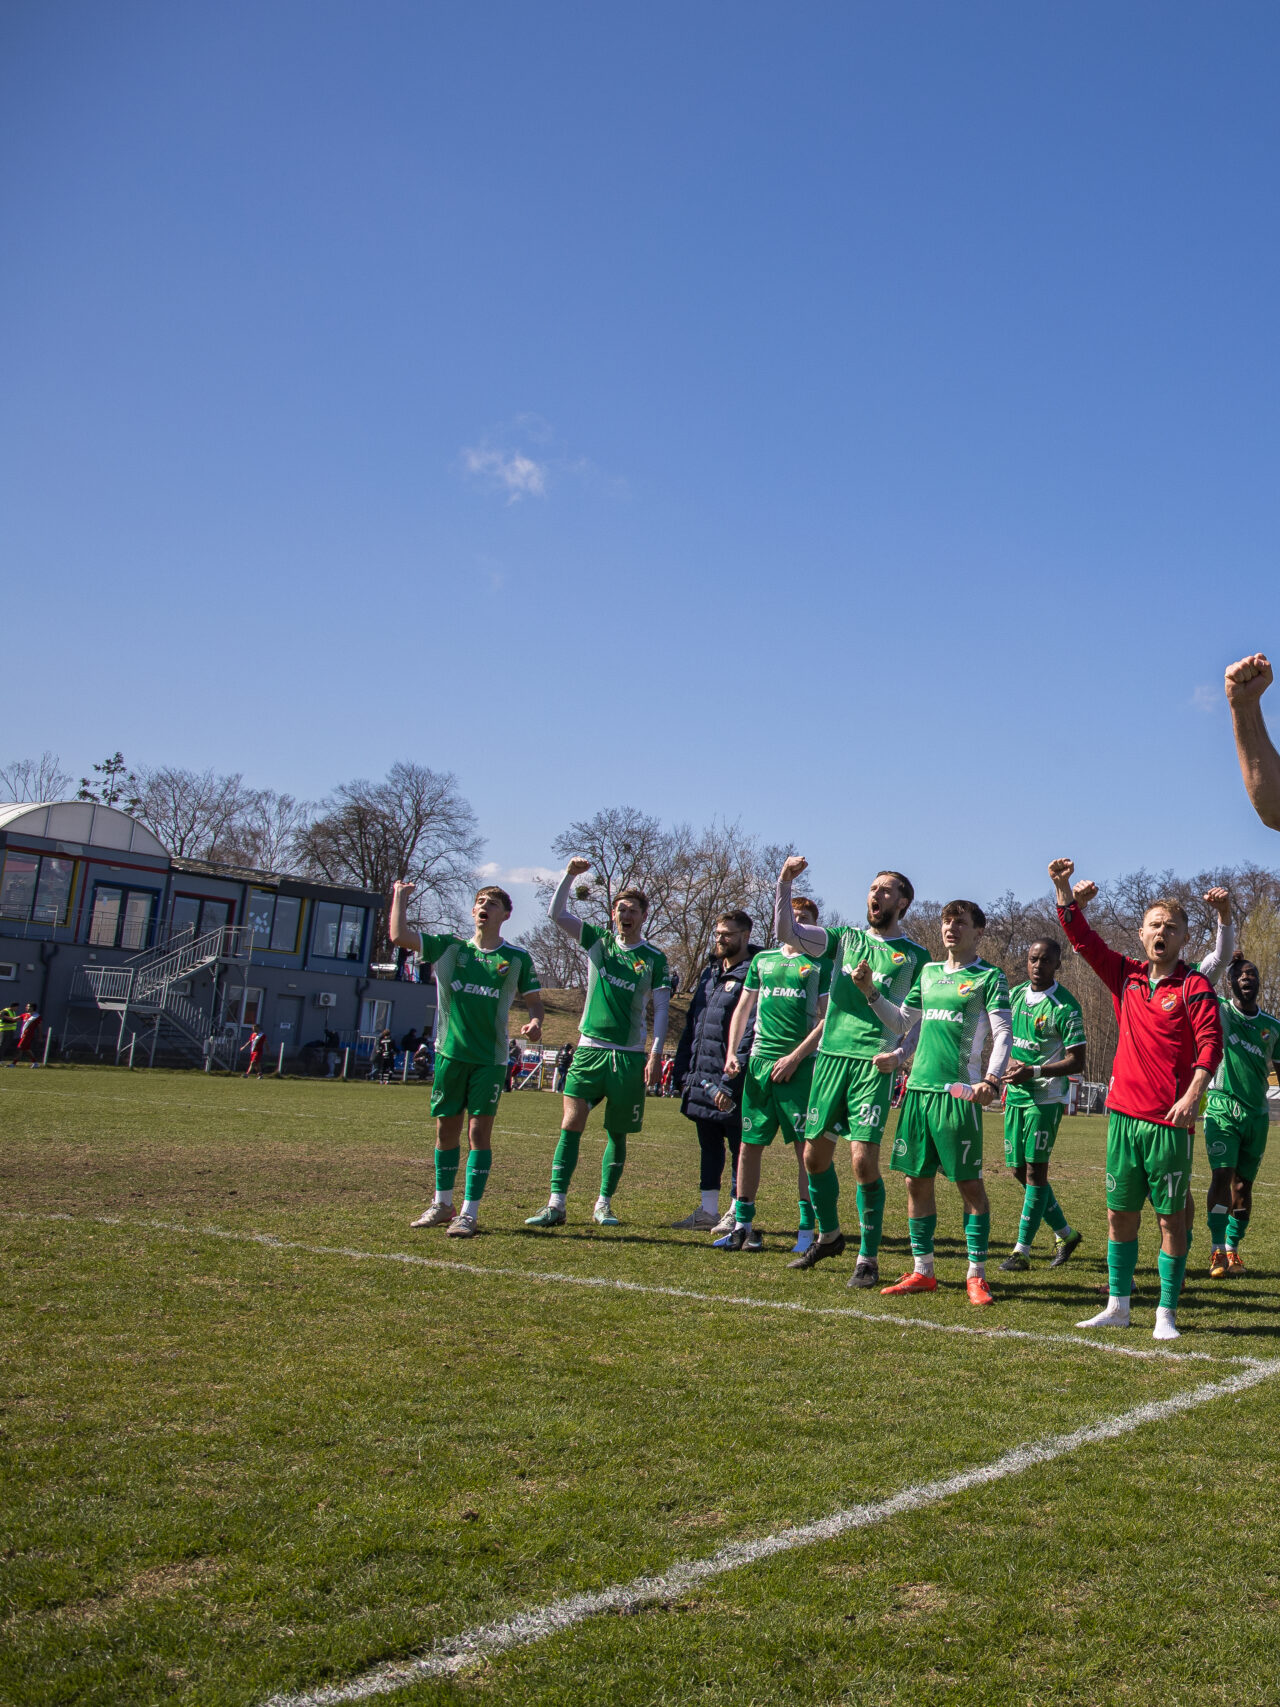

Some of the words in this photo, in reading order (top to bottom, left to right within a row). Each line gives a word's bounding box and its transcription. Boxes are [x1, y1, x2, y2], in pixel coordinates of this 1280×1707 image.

[463, 982, 500, 999] EMKA
[772, 986, 807, 999] EMKA
[926, 1008, 964, 1024] EMKA
[1013, 1036, 1041, 1052] EMKA
[490, 1085, 500, 1103] 3
[632, 1104, 640, 1122] 5
[858, 1103, 882, 1128] 98
[1034, 1130, 1049, 1151] 13
[961, 1140, 972, 1165] 7
[1163, 1171, 1183, 1198] 17
